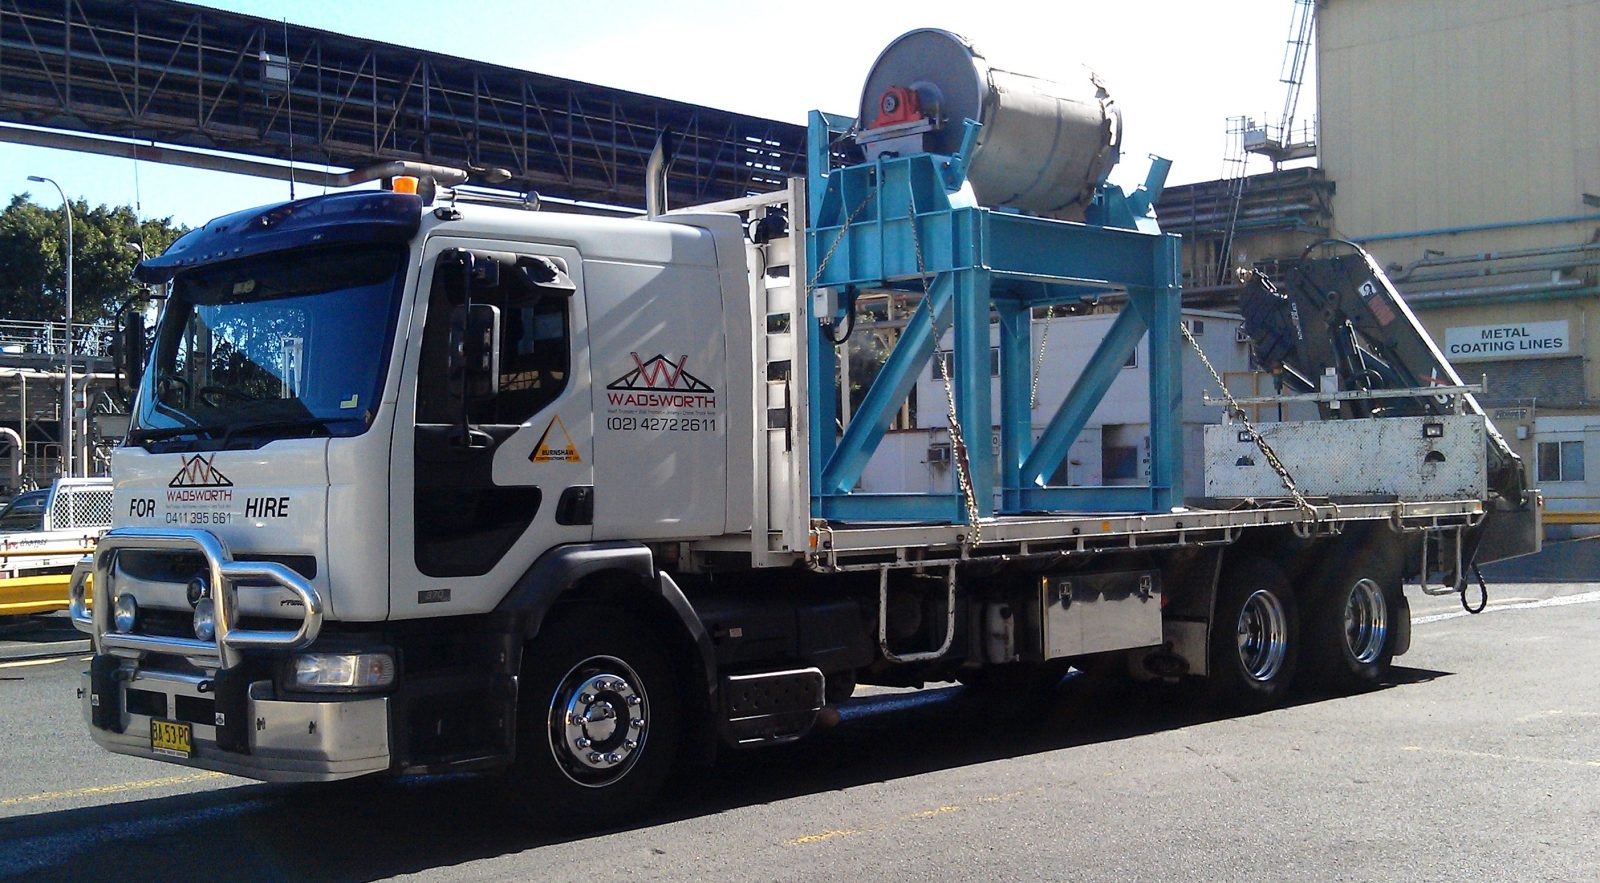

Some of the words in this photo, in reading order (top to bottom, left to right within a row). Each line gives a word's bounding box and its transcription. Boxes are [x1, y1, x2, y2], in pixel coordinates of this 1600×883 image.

[1481, 327, 1530, 339] METAL
[1450, 340, 1515, 354] COATING
[1519, 337, 1563, 350] LINES
[607, 393, 716, 408] WADSWORTH
[607, 417, 637, 431] (02)
[640, 418, 678, 431] 4272
[681, 419, 716, 432] 2611
[166, 489, 232, 502] WADSWORTH
[129, 498, 156, 517] FOR
[245, 496, 290, 518] HIRE
[166, 512, 188, 524] 0411
[190, 512, 209, 524] 395
[212, 512, 231, 524] 661
